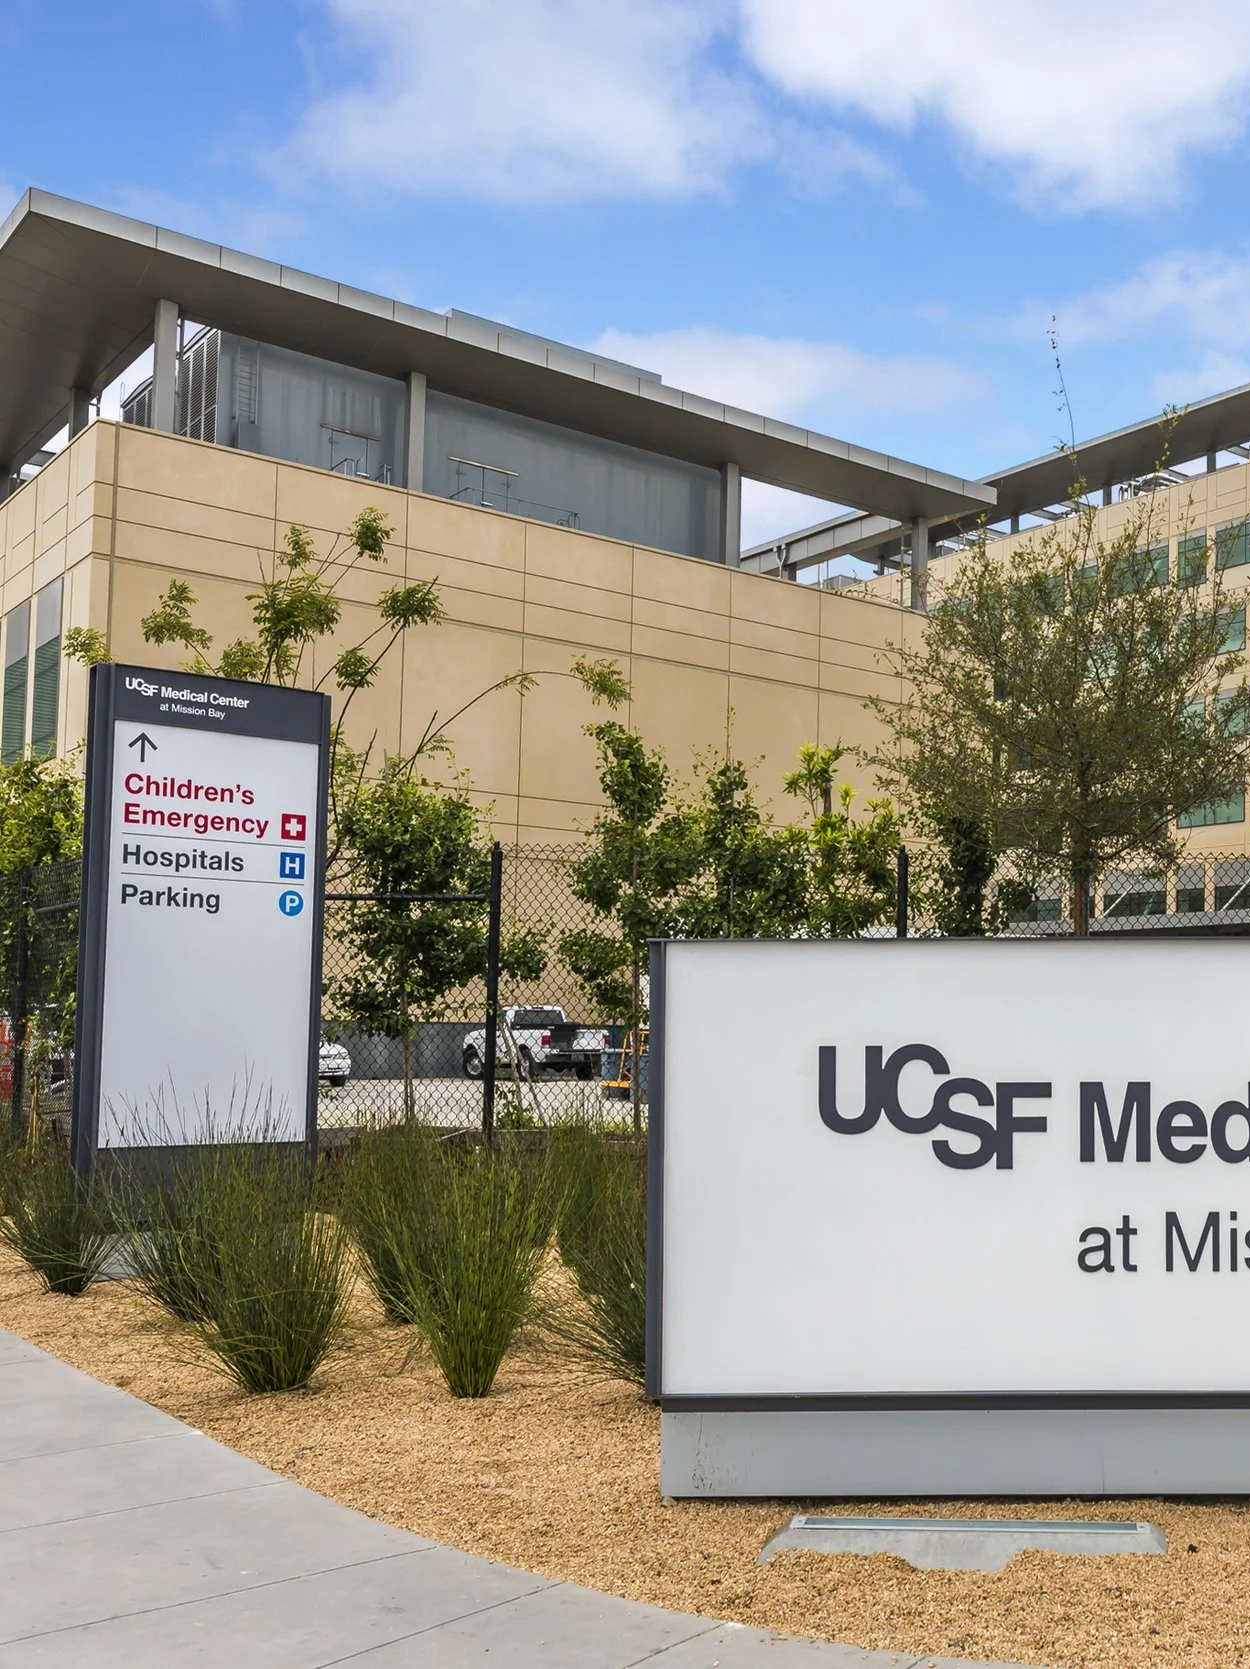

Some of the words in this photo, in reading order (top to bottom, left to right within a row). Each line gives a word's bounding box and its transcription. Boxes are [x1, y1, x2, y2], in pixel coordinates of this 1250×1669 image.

[125, 677, 159, 697] UCSF
[161, 686, 208, 704] Medical
[210, 693, 249, 709] Center
[160, 703, 169, 712] at
[171, 704, 206, 717] Mission
[208, 708, 226, 721] Bay
[124, 773, 255, 805] Children’s
[123, 803, 269, 838] Emergency
[122, 843, 245, 873] Hospitals
[284, 856, 300, 875] H
[120, 883, 220, 914] Parking
[818, 1043, 1053, 1170] UCSF
[1078, 1215, 1138, 1273] at
